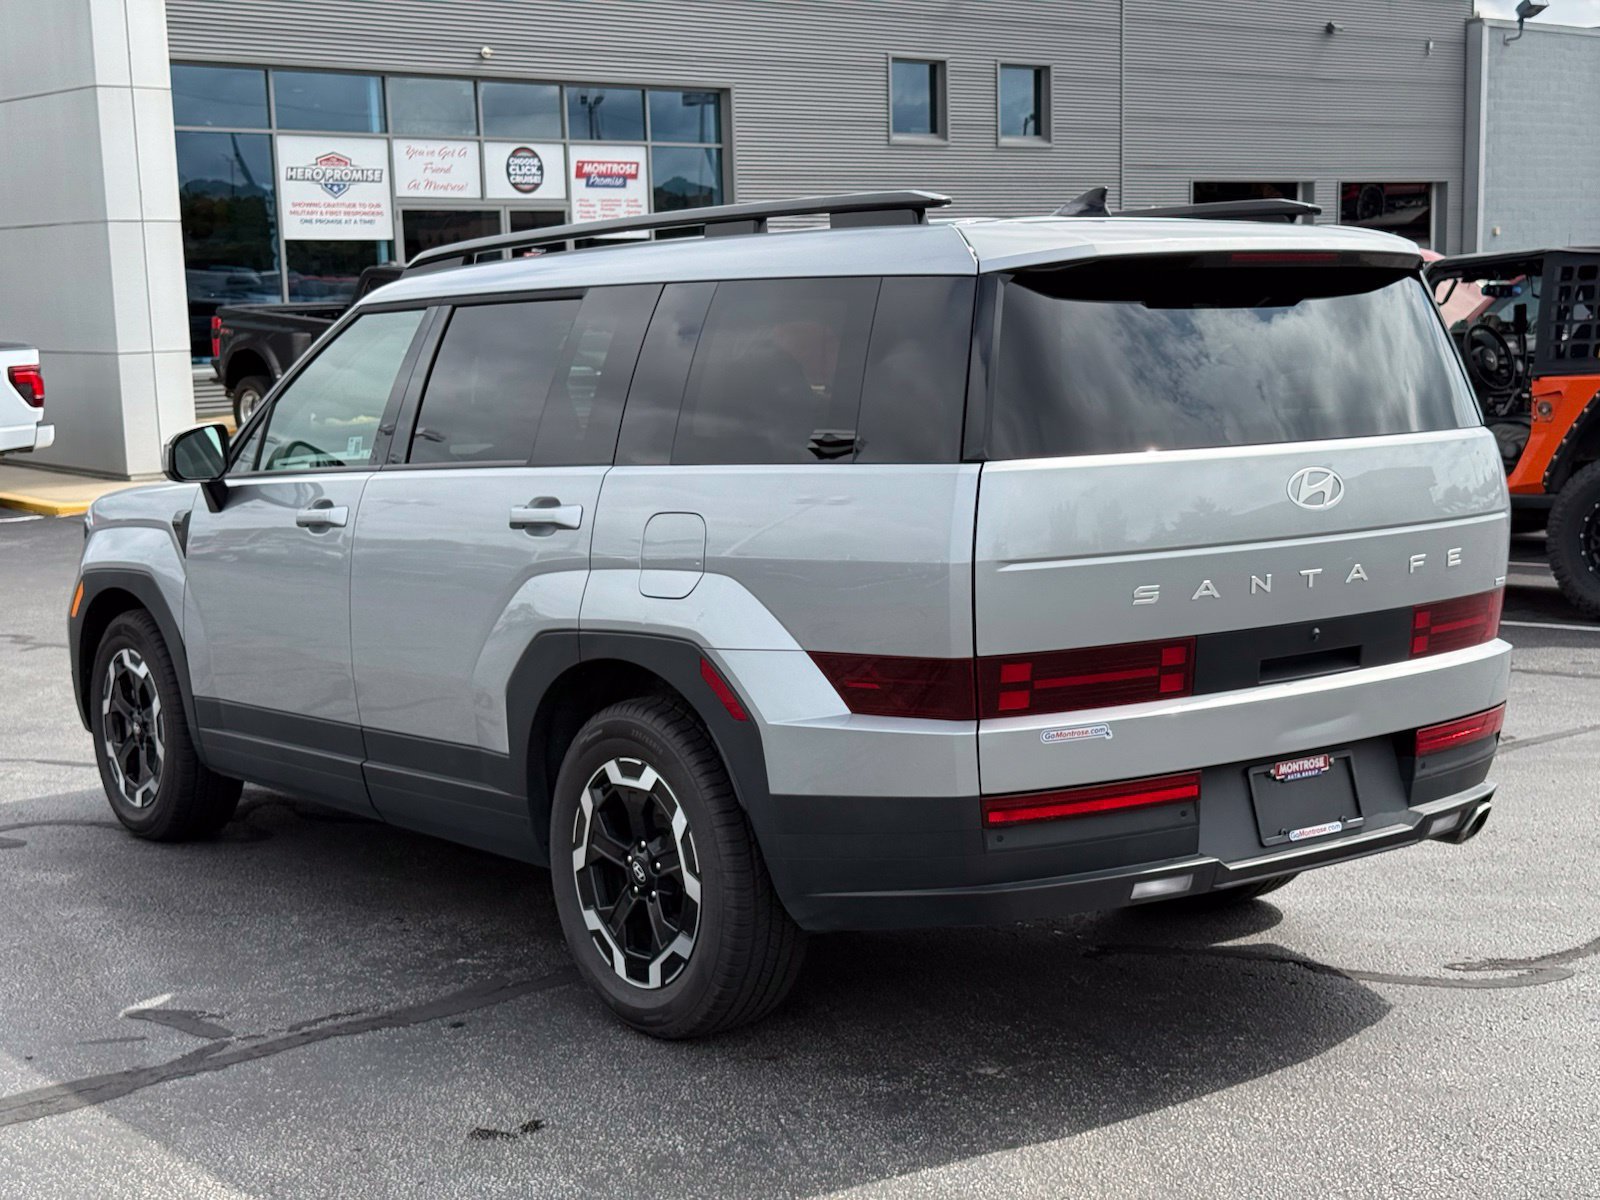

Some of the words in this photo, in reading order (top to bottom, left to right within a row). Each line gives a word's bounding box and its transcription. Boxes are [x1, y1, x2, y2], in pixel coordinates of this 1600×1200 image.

[287, 167, 324, 180] HERO
[325, 169, 382, 182] PROMISE
[582, 162, 637, 175] MONTROSE
[589, 173, 625, 186] Promise
[1132, 563, 1369, 606] SANTA
[1409, 547, 1462, 574] FE
[1044, 726, 1106, 740] GoMontrose.com
[1279, 757, 1325, 774] MONTROSE
[1290, 824, 1341, 839] GoMontrose.com
